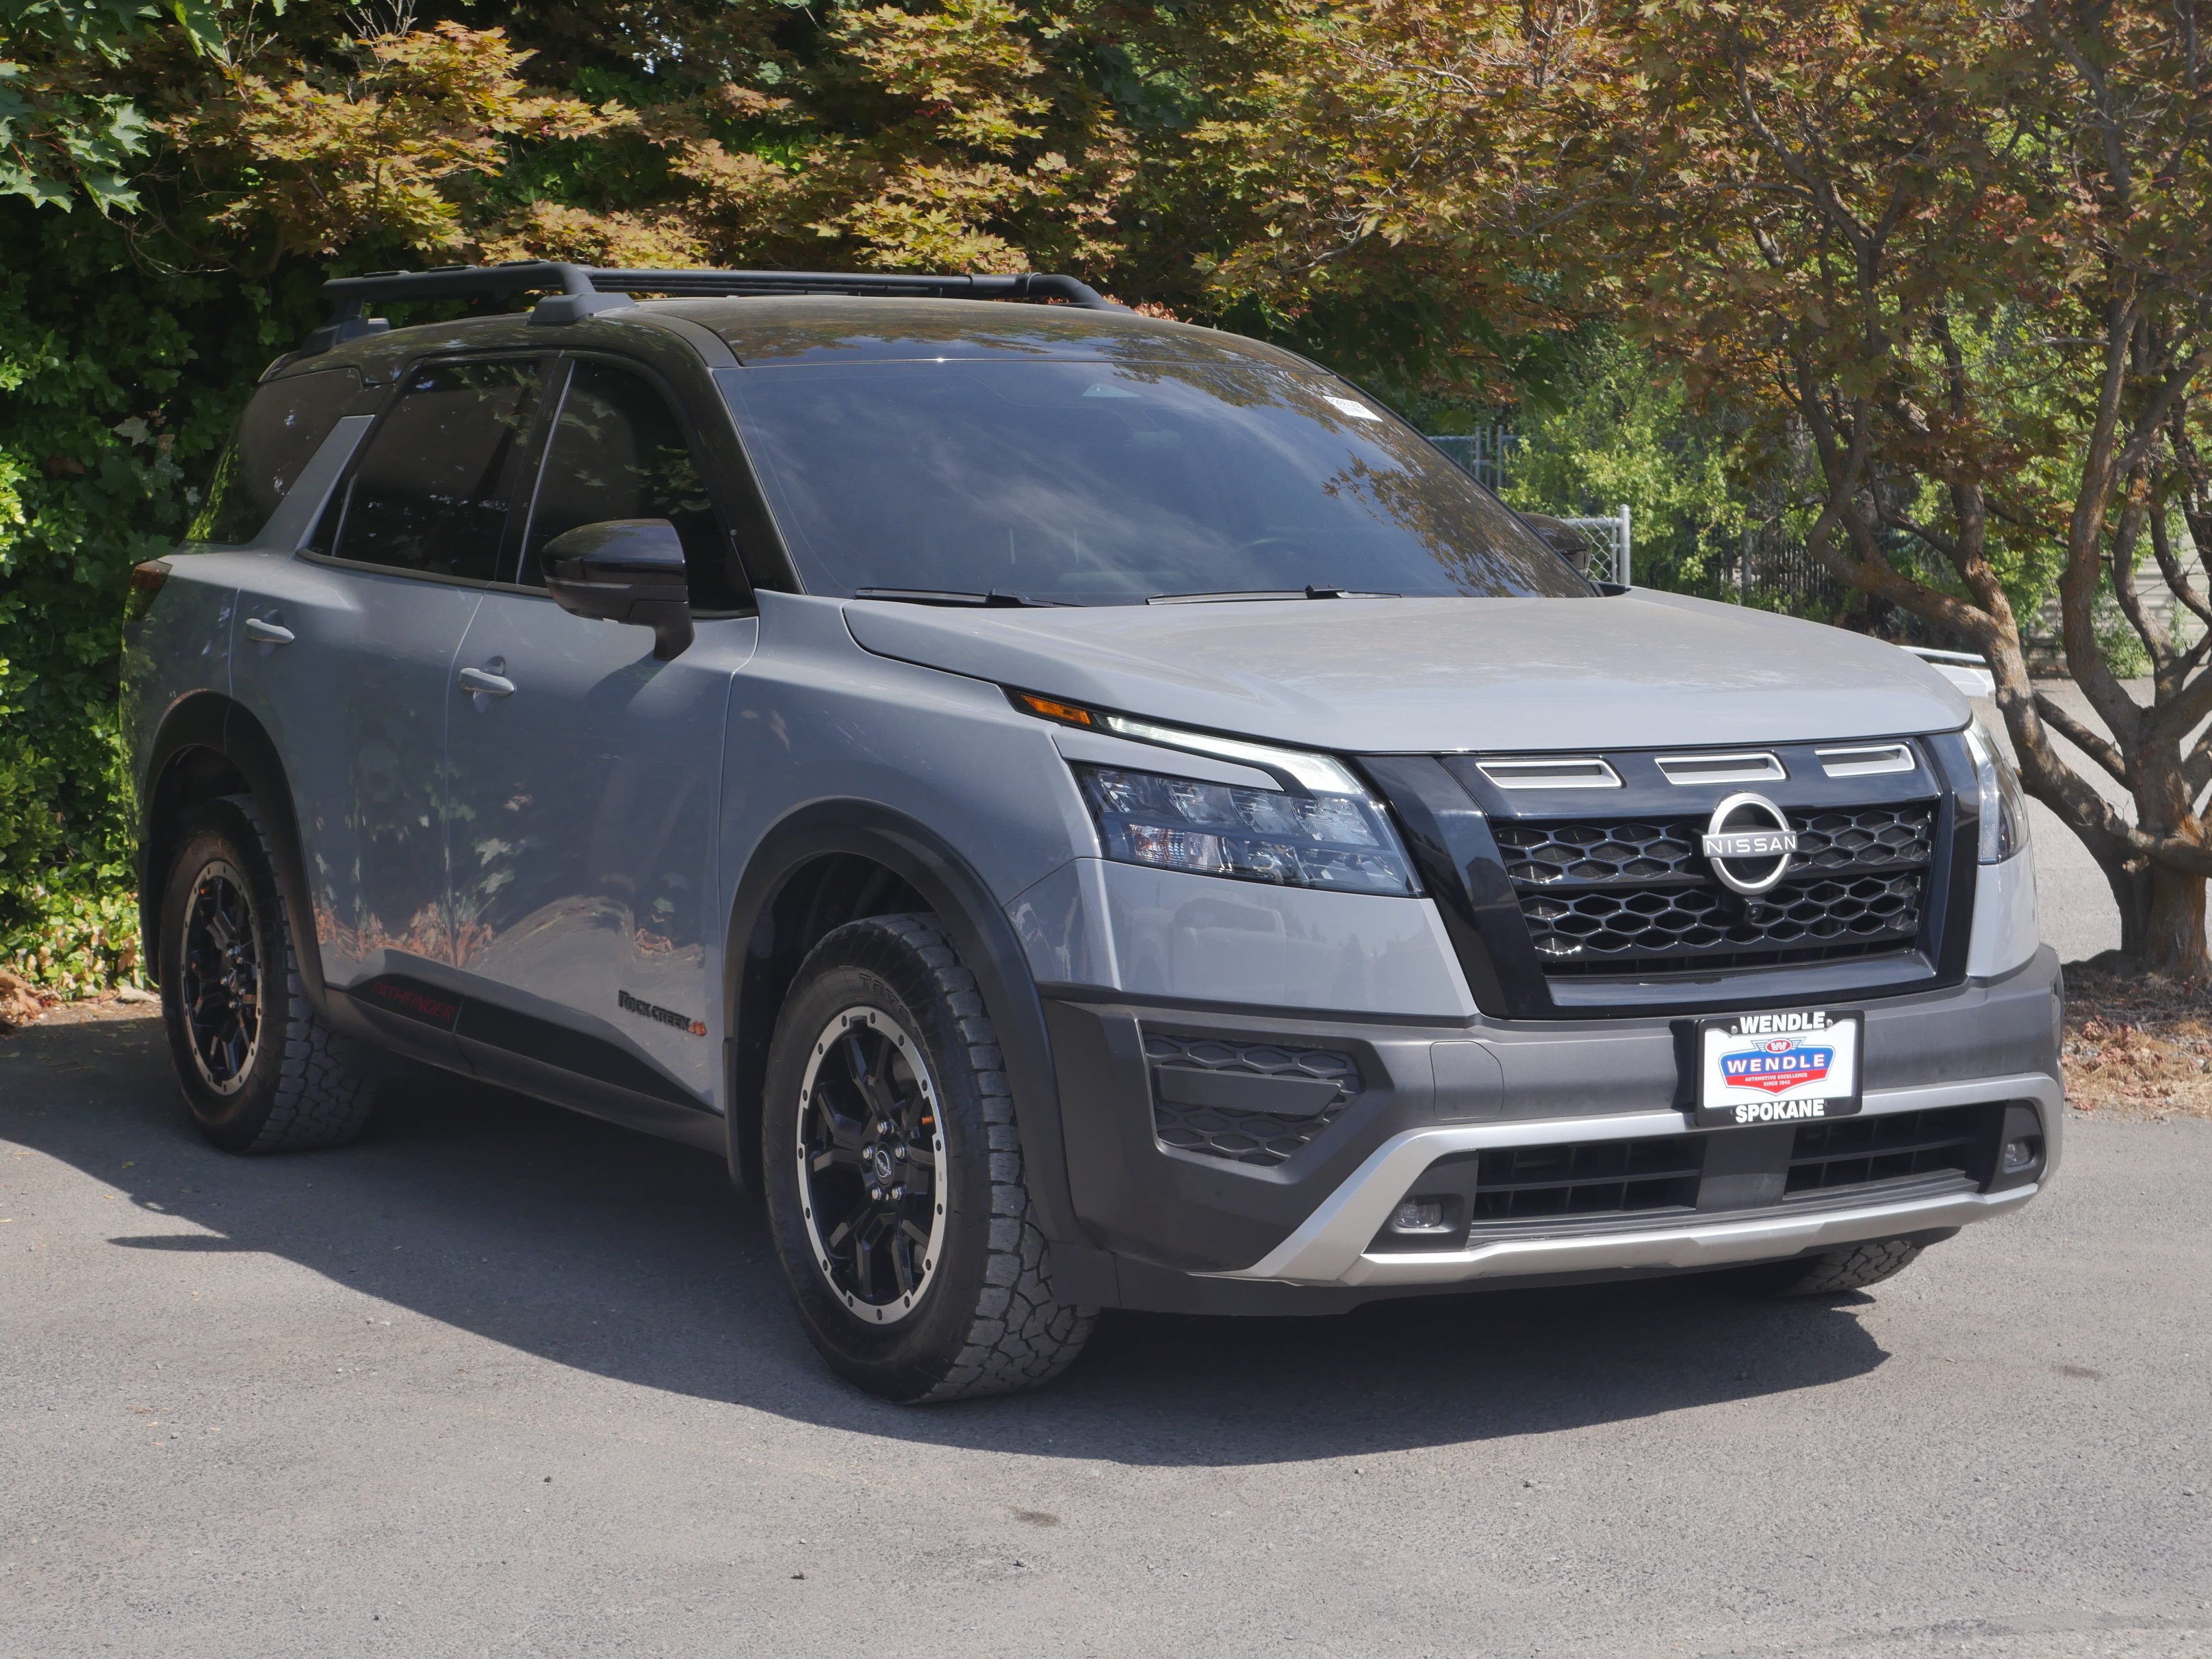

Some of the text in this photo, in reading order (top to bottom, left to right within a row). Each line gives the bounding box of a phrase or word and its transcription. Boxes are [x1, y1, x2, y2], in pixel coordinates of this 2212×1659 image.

[1706, 835, 1796, 854] NISSAN
[373, 981, 455, 1021] PATHFINDER
[618, 990, 691, 1031] ROCK CREEK
[859, 973, 911, 1025] TOYO
[1740, 1011, 1825, 1034] WENDLE
[1727, 1054, 1825, 1073] WENDLE
[1736, 1098, 1825, 1123] SPOKANE
